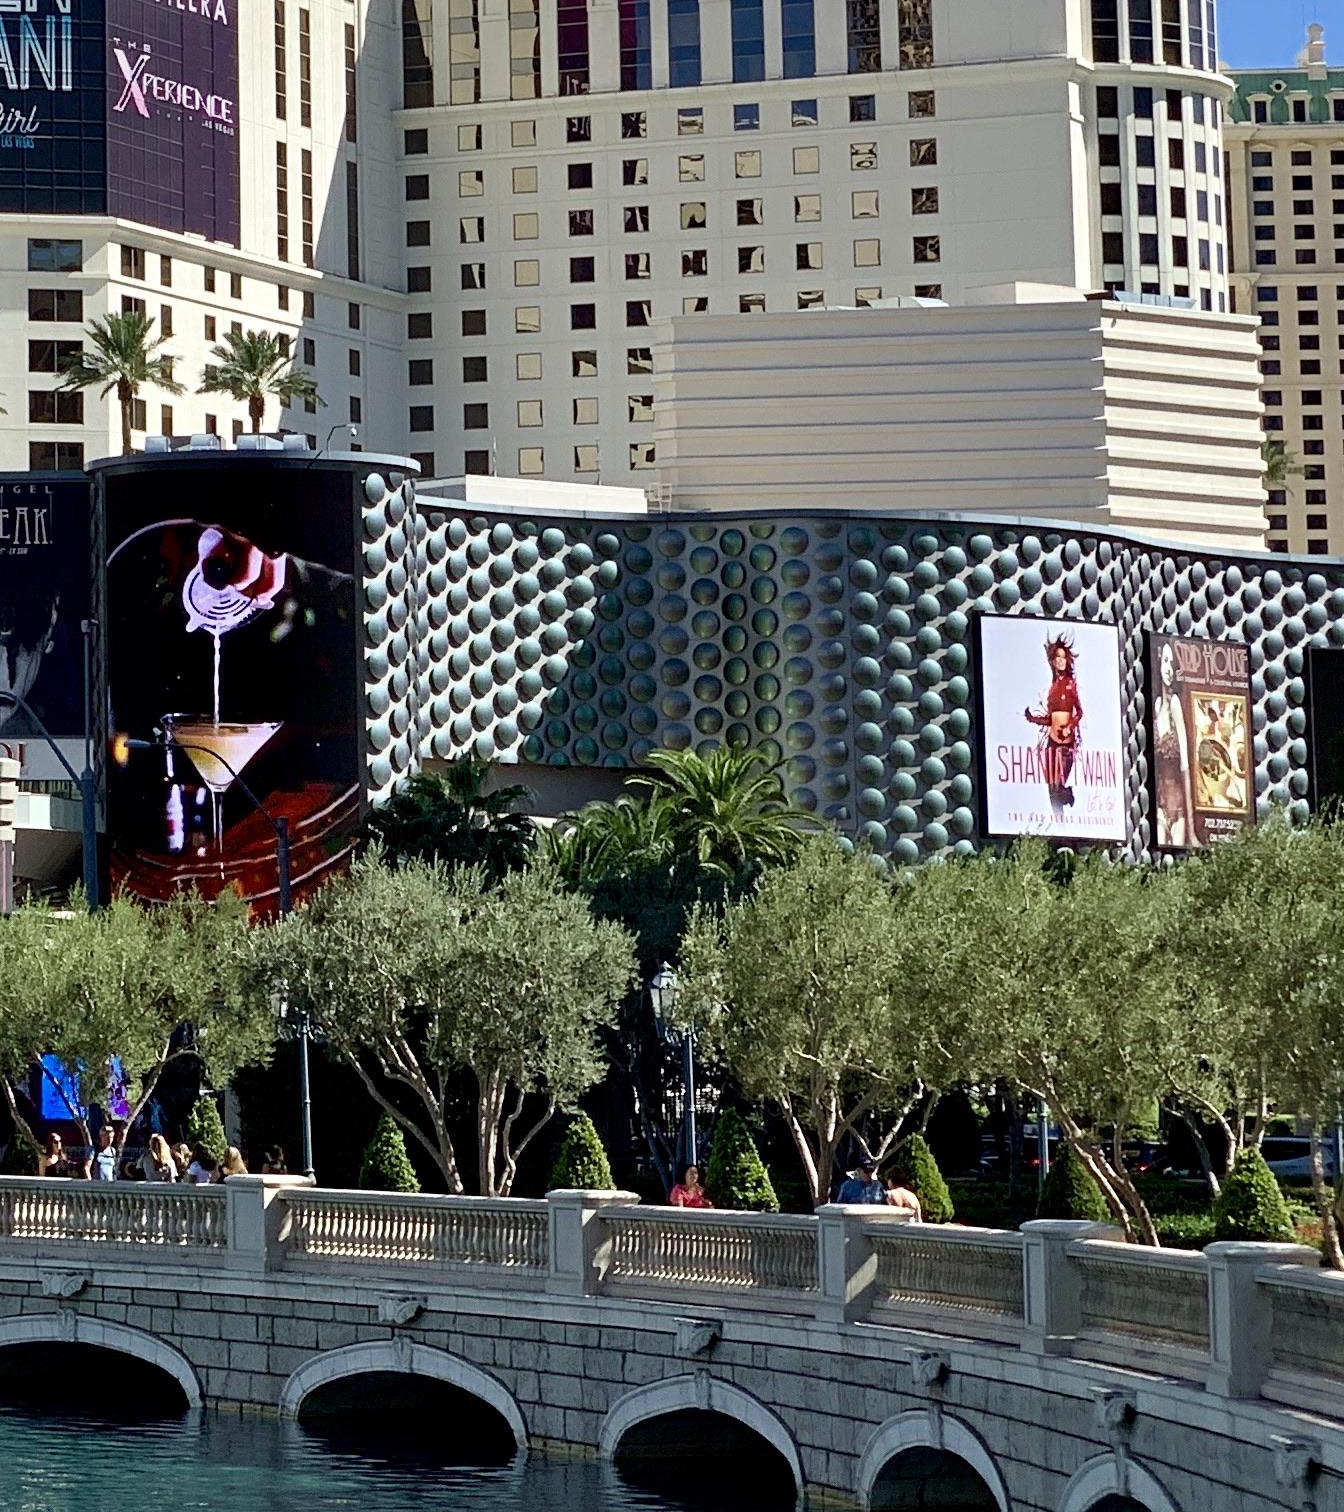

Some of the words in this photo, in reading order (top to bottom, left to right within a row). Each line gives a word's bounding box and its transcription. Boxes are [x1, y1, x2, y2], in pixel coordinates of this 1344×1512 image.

[112, 48, 234, 124] XPERIENCE
[997, 745, 1066, 785] SHANIA
[1070, 749, 1118, 789] TWAIN
